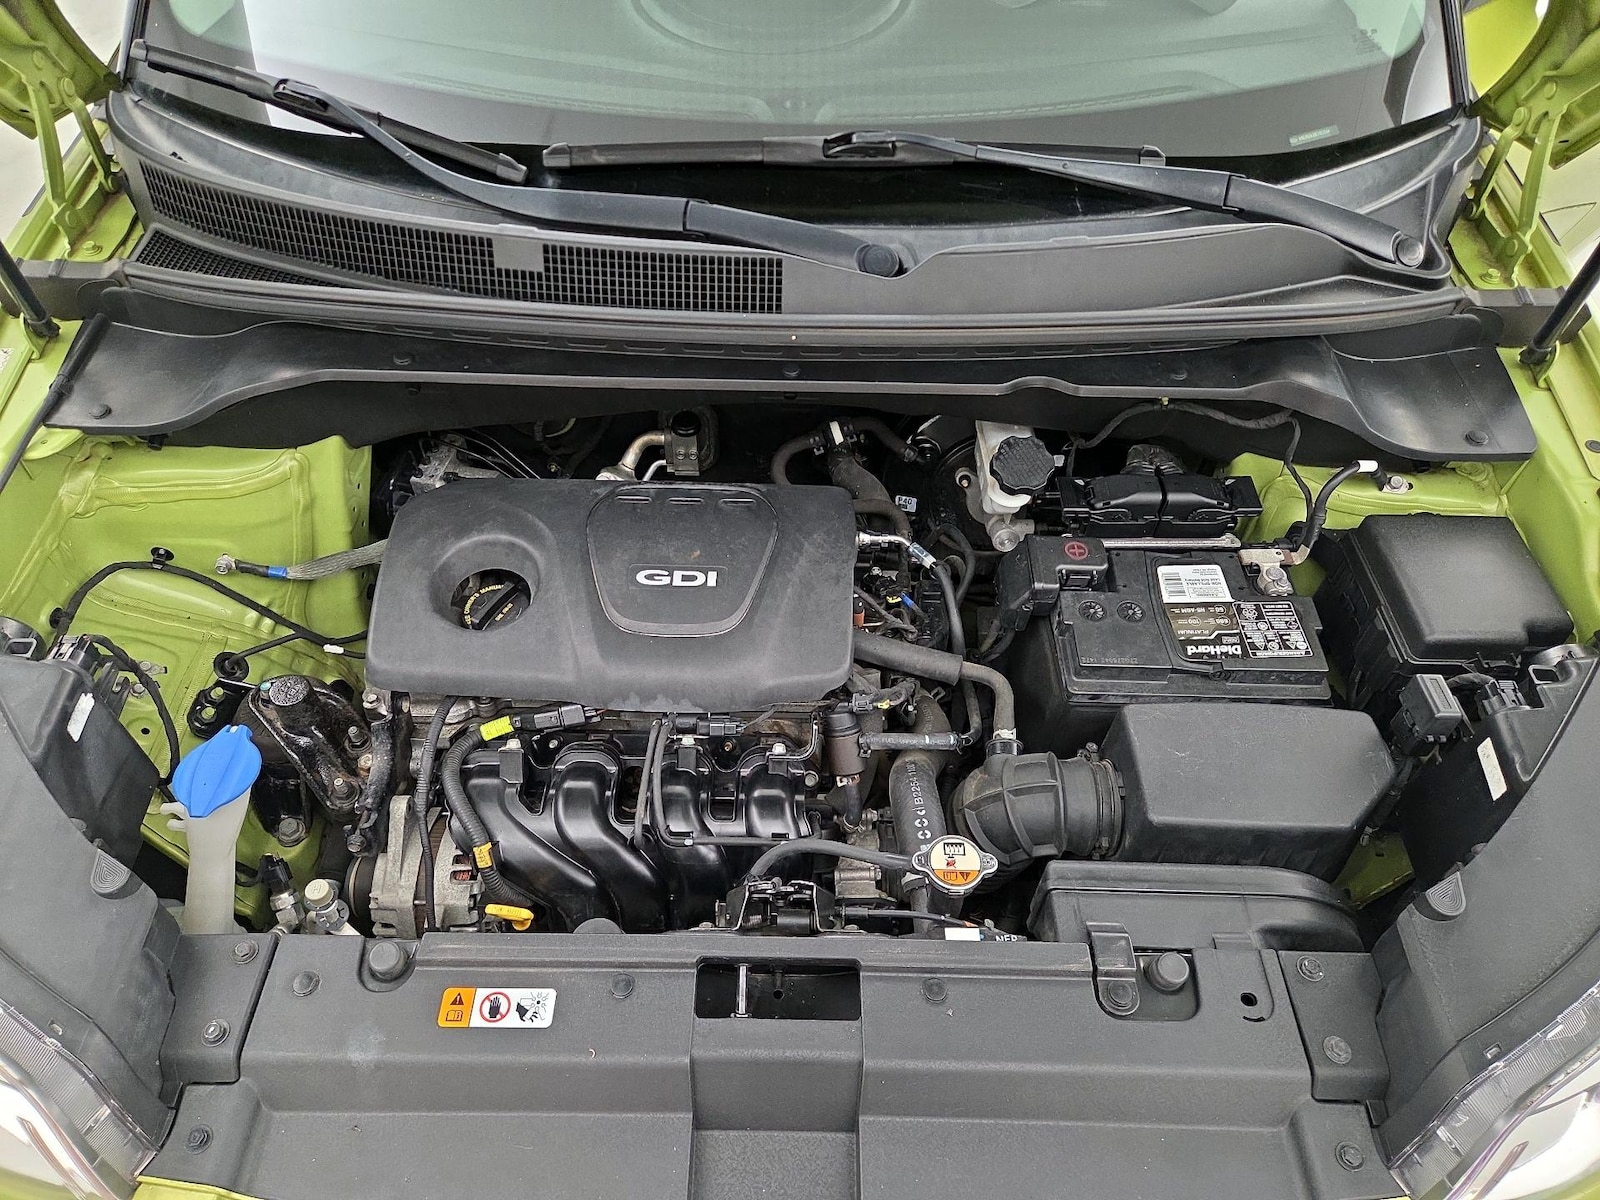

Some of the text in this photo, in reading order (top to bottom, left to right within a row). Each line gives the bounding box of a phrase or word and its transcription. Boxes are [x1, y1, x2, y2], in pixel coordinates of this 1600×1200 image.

[635, 569, 718, 587] GDI
[463, 592, 480, 615] OWNER'S
[1186, 644, 1242, 656] DieHard
